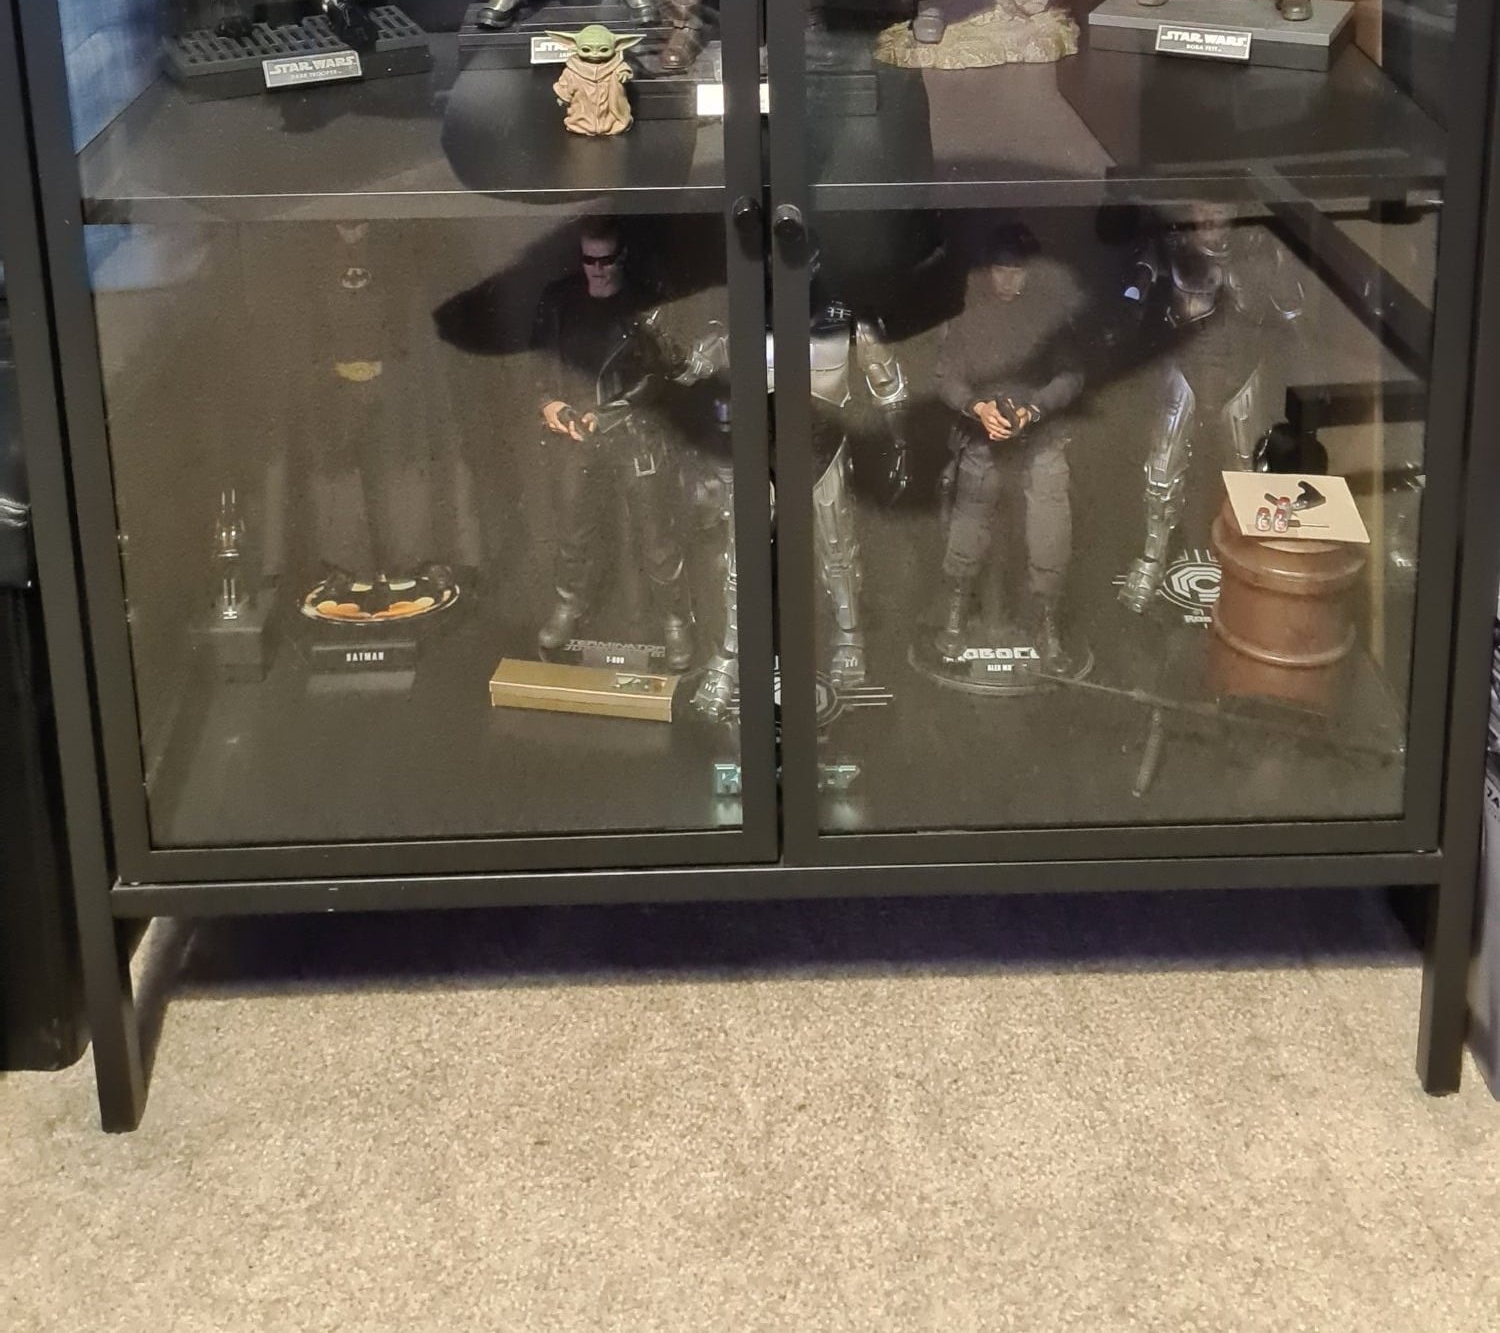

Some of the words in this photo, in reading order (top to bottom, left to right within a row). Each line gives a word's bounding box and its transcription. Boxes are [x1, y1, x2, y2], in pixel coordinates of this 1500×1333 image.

[1161, 31, 1203, 43] STAR
[1204, 34, 1248, 47] WARS
[269, 61, 313, 75] STAR
[312, 56, 357, 70] WARS
[346, 652, 385, 662] BATMAN
